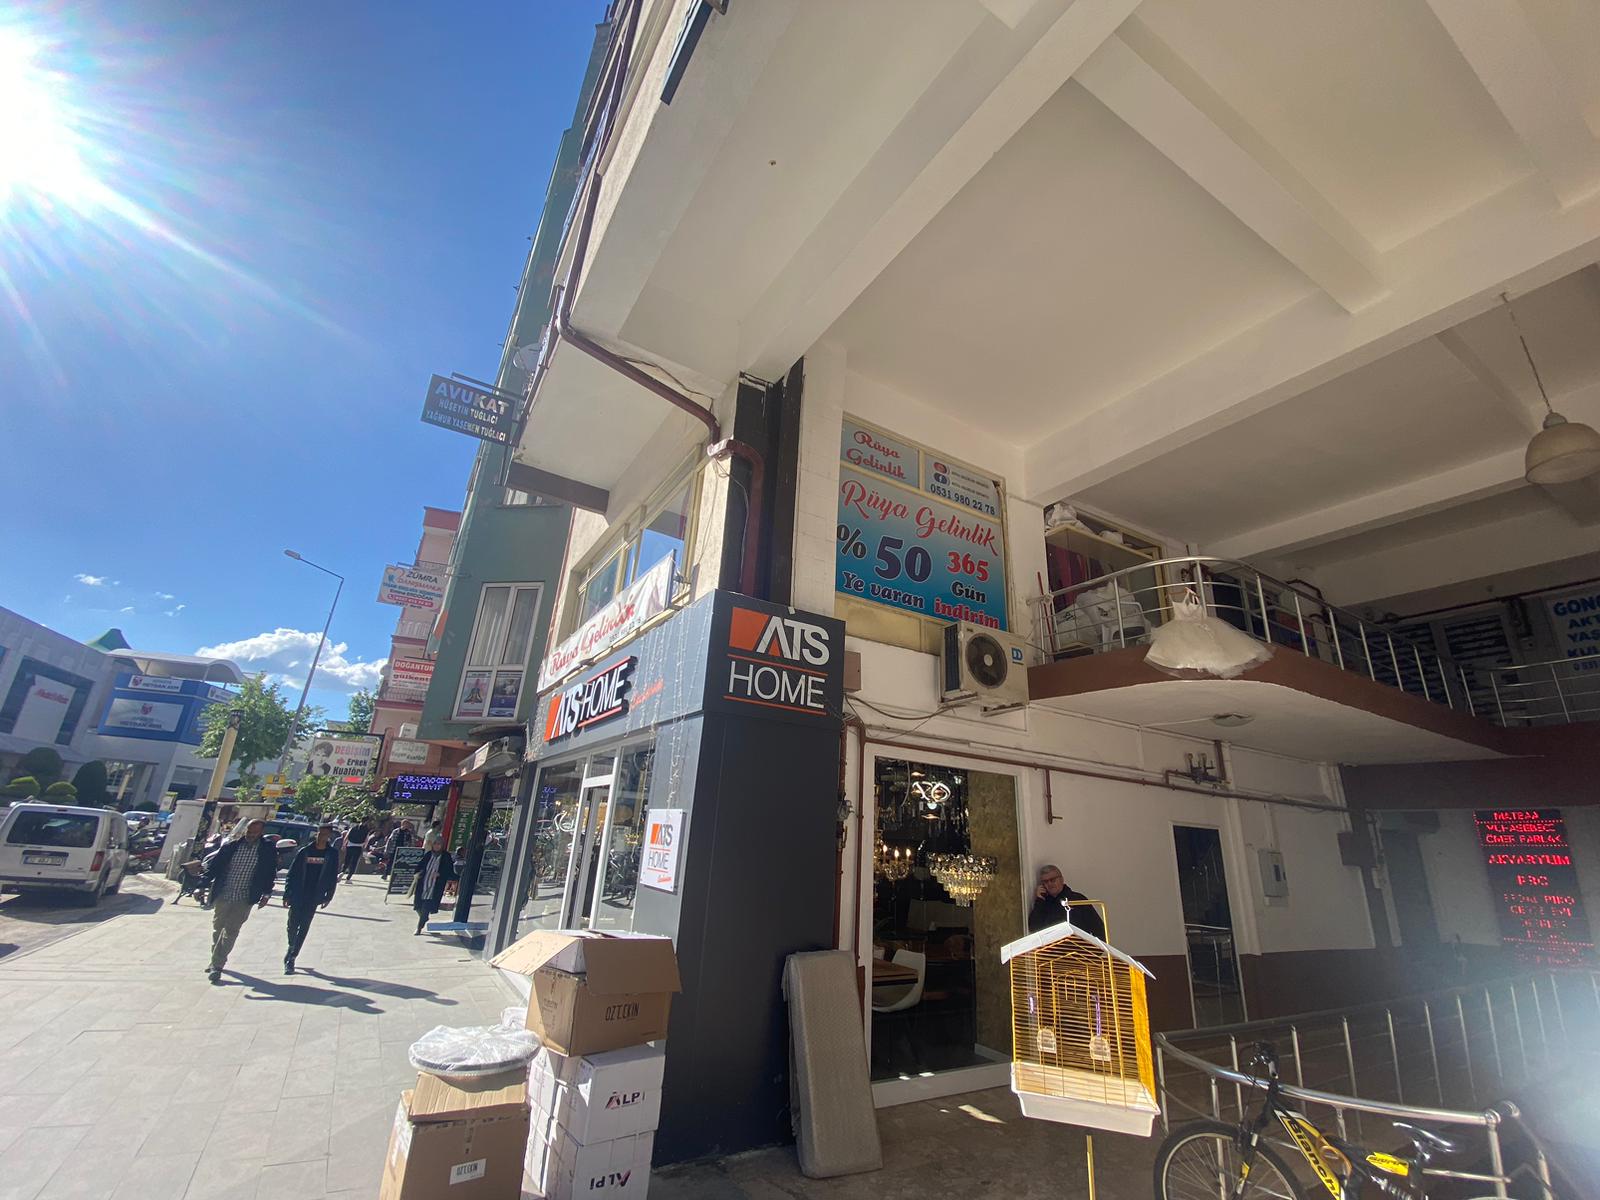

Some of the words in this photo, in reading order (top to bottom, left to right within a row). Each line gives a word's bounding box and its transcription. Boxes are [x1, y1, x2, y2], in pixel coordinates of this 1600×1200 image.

[435, 382, 509, 415] AVUKAT
[853, 430, 900, 459] Rüya
[846, 448, 906, 480] Gelinlik
[930, 484, 952, 499] 0531
[954, 492, 971, 506] 980
[972, 499, 984, 512] 22
[984, 504, 996, 515] 78
[841, 480, 909, 520] Rüya
[915, 506, 998, 556] Gelinlik
[874, 534, 933, 583] 50
[946, 551, 990, 582] 365
[842, 571, 865, 593] Ye
[869, 582, 925, 609] varan
[934, 598, 999, 629] indirim
[951, 581, 987, 603] Gün
[753, 615, 831, 667] ATS
[551, 683, 585, 740] ATS
[578, 661, 629, 721] HOME
[728, 660, 826, 709] HOME
[647, 850, 670, 871] HOME
